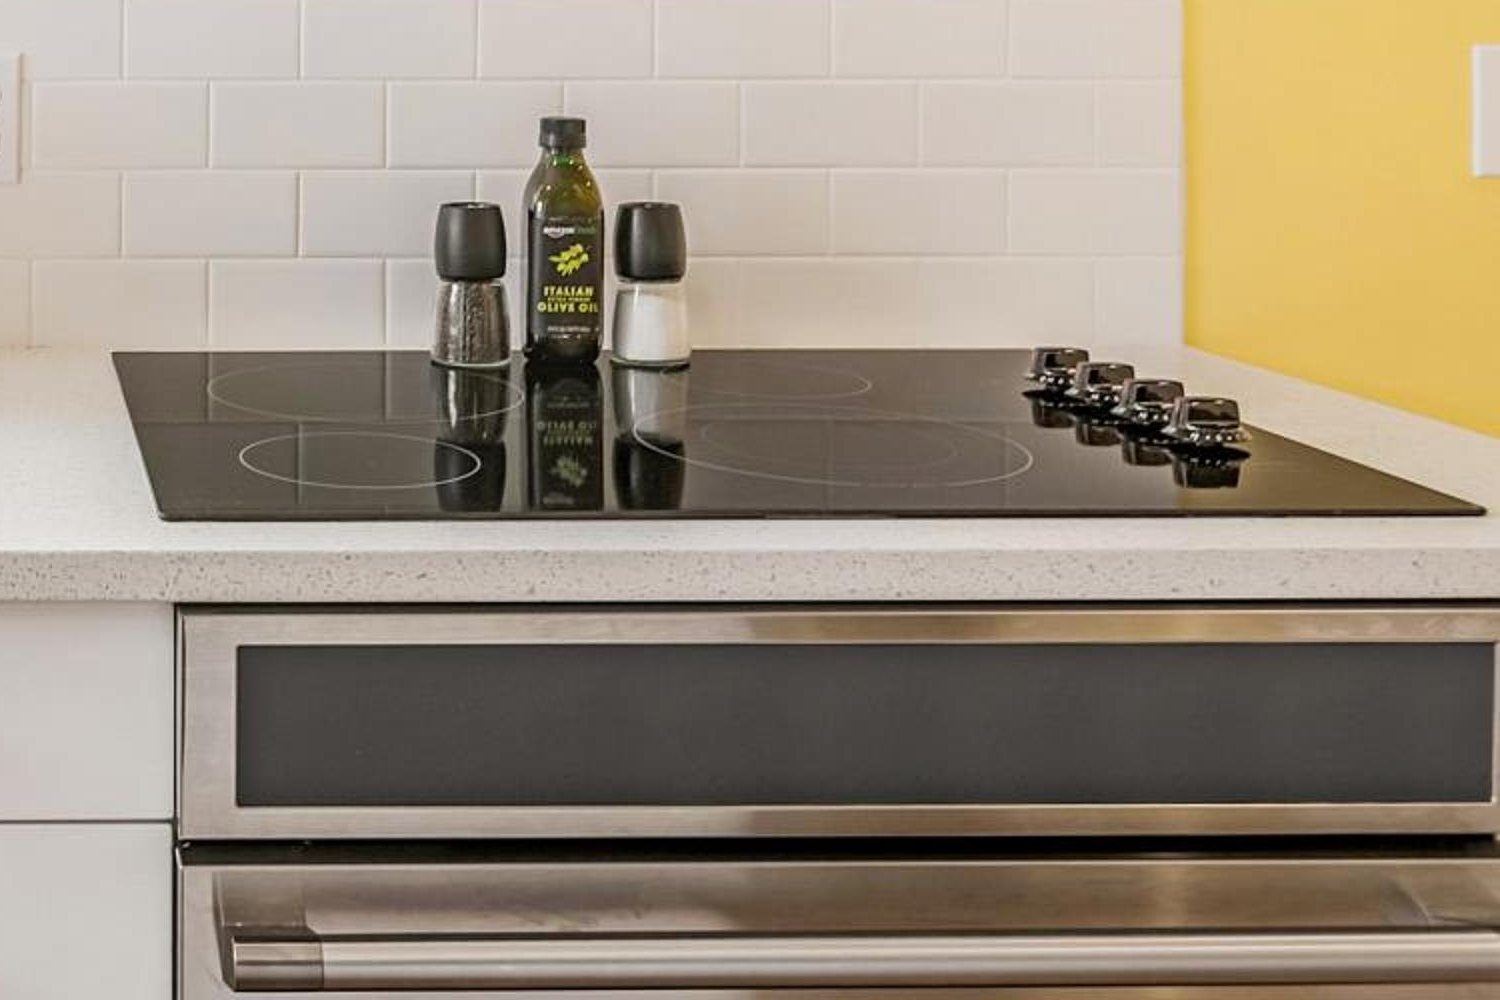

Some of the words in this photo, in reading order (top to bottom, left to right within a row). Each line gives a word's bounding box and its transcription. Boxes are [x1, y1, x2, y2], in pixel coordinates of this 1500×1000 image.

[543, 285, 594, 297] ITALIAN
[537, 302, 575, 313] OLIVE
[578, 302, 599, 313] OIL
